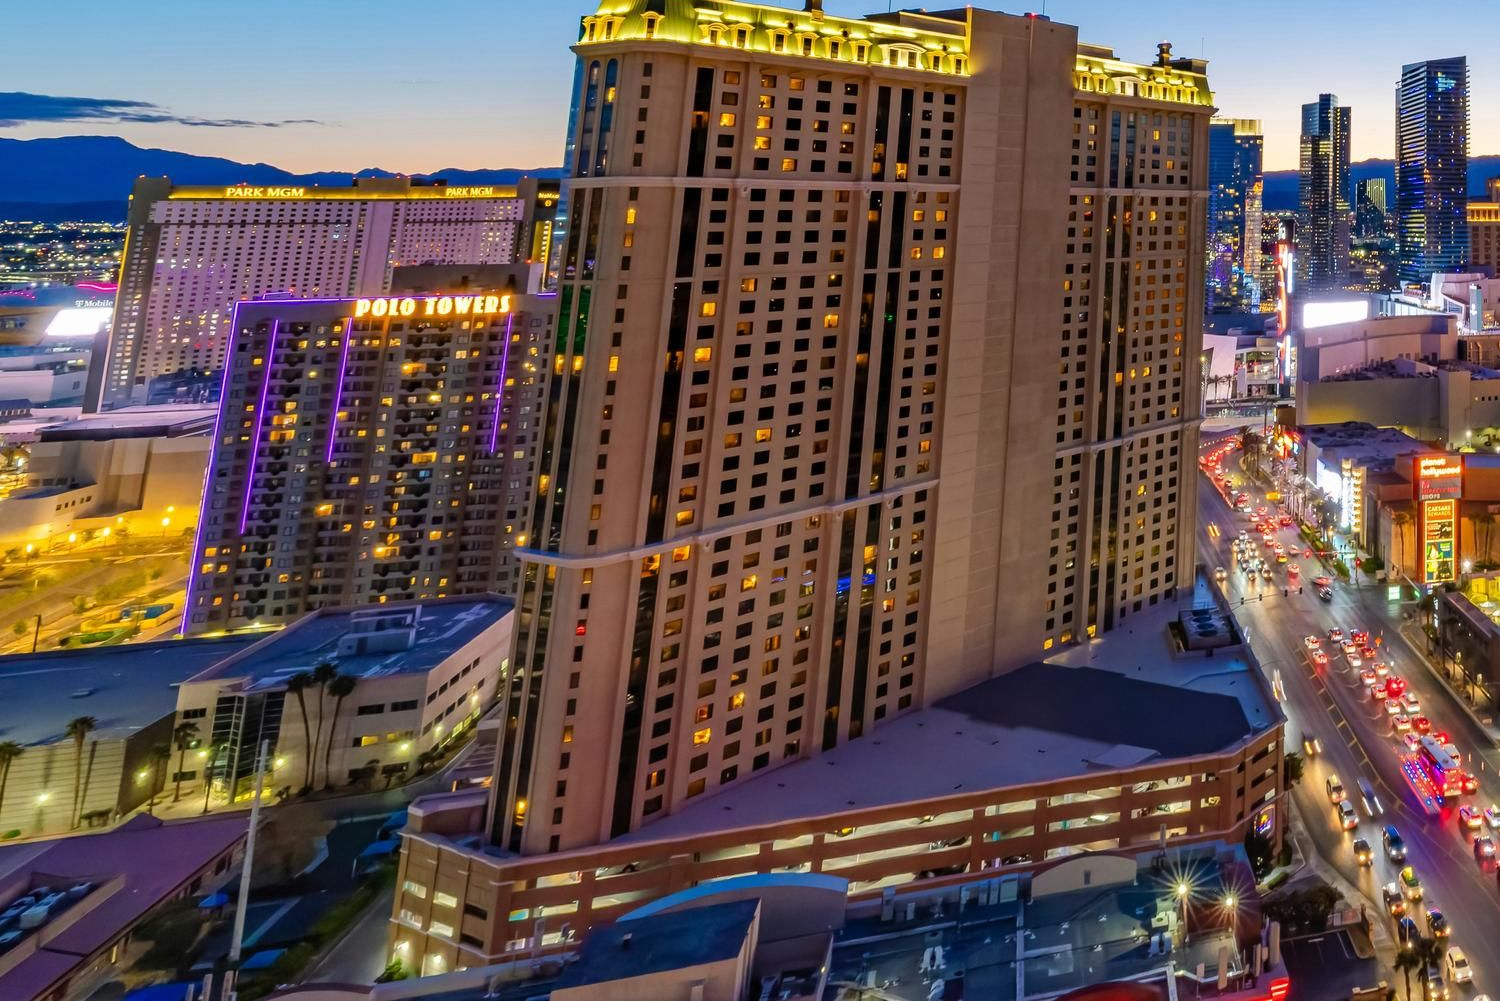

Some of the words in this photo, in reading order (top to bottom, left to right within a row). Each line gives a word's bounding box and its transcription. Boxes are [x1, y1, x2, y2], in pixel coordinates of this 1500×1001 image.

[226, 187, 264, 197] PARK
[267, 187, 305, 197] MGM
[446, 187, 468, 196] PARK
[470, 187, 493, 195] MGM
[355, 298, 415, 317] POLO
[425, 295, 510, 315] TOWERS
[1421, 458, 1446, 466] planet
[1421, 464, 1461, 477] hollywood
